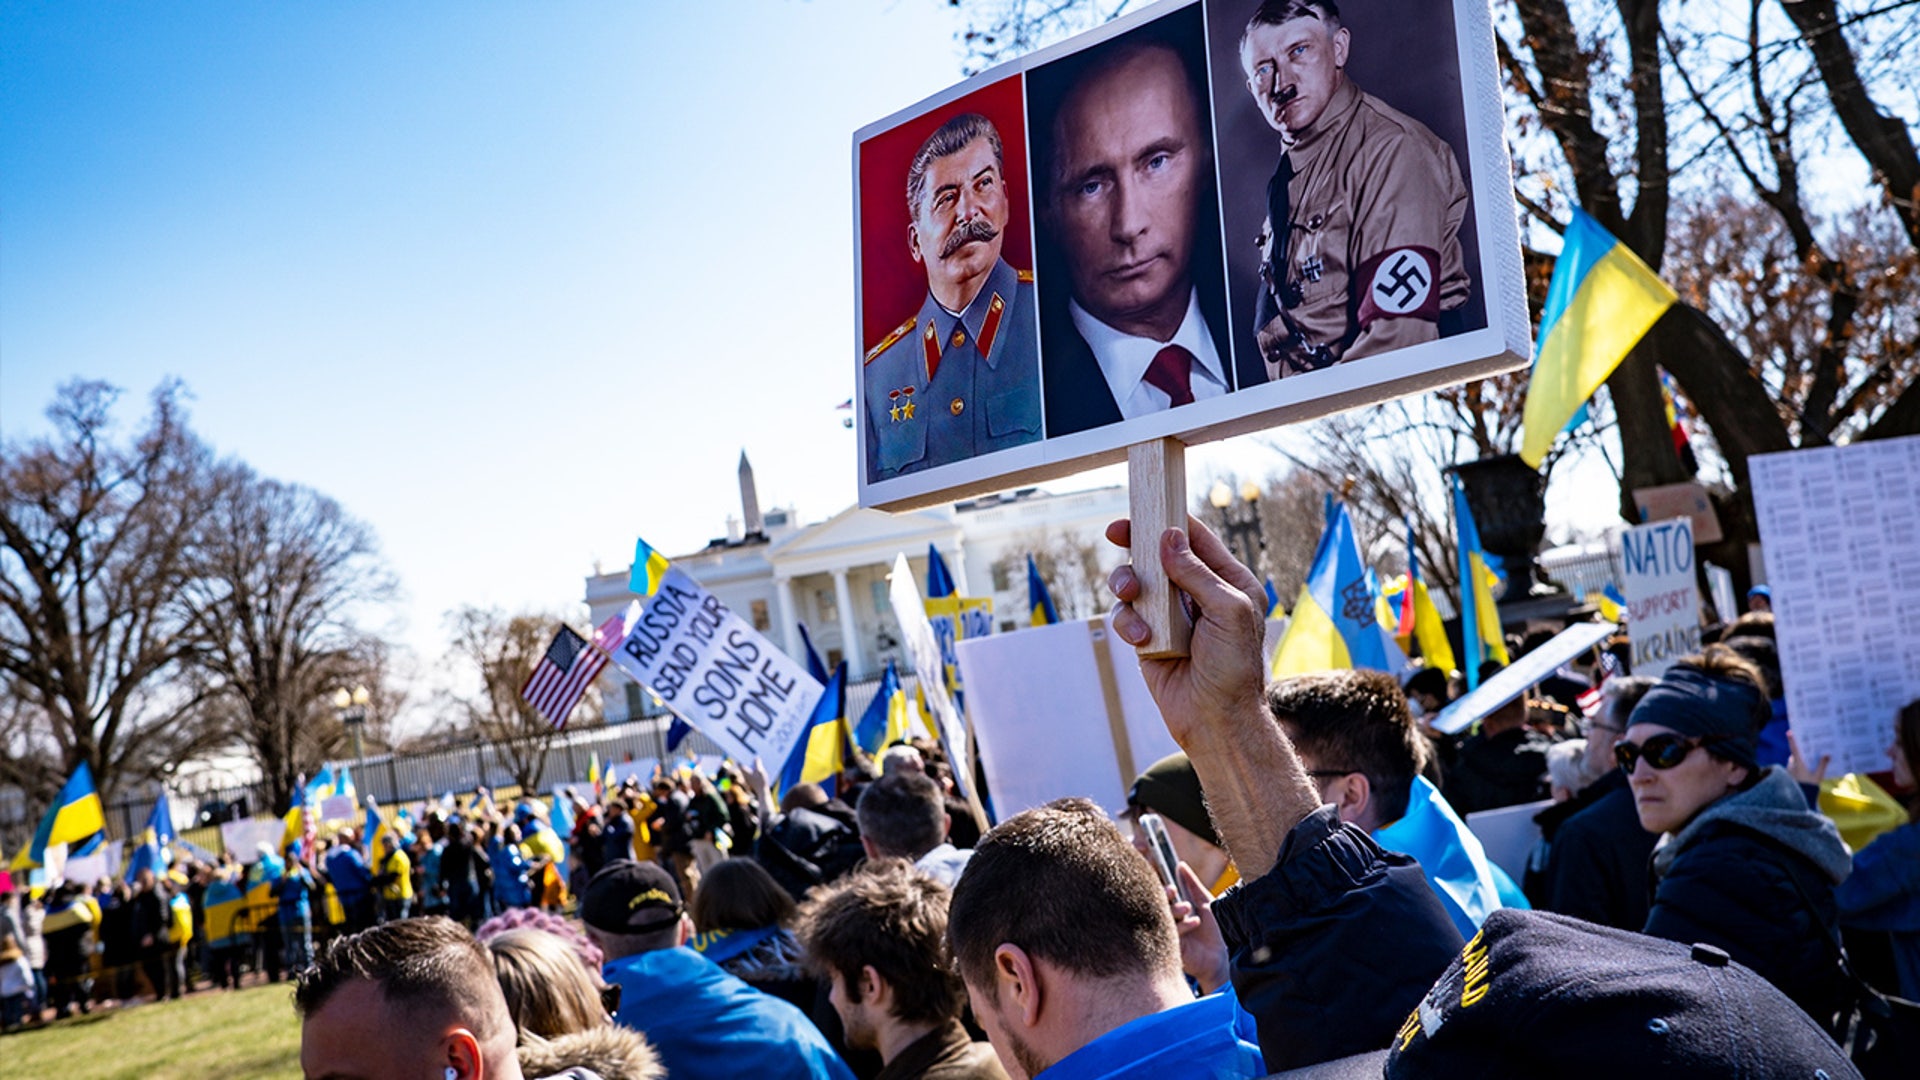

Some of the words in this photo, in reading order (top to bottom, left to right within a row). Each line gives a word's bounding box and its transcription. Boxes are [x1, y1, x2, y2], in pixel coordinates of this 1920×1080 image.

[1622, 524, 1692, 576] NATO
[624, 584, 699, 669] RUSSIA
[652, 643, 698, 701] SEND
[685, 595, 730, 648] YOUR
[1627, 587, 1690, 622] SUPPORT
[693, 629, 760, 720] SONS
[726, 659, 796, 755] HOME
